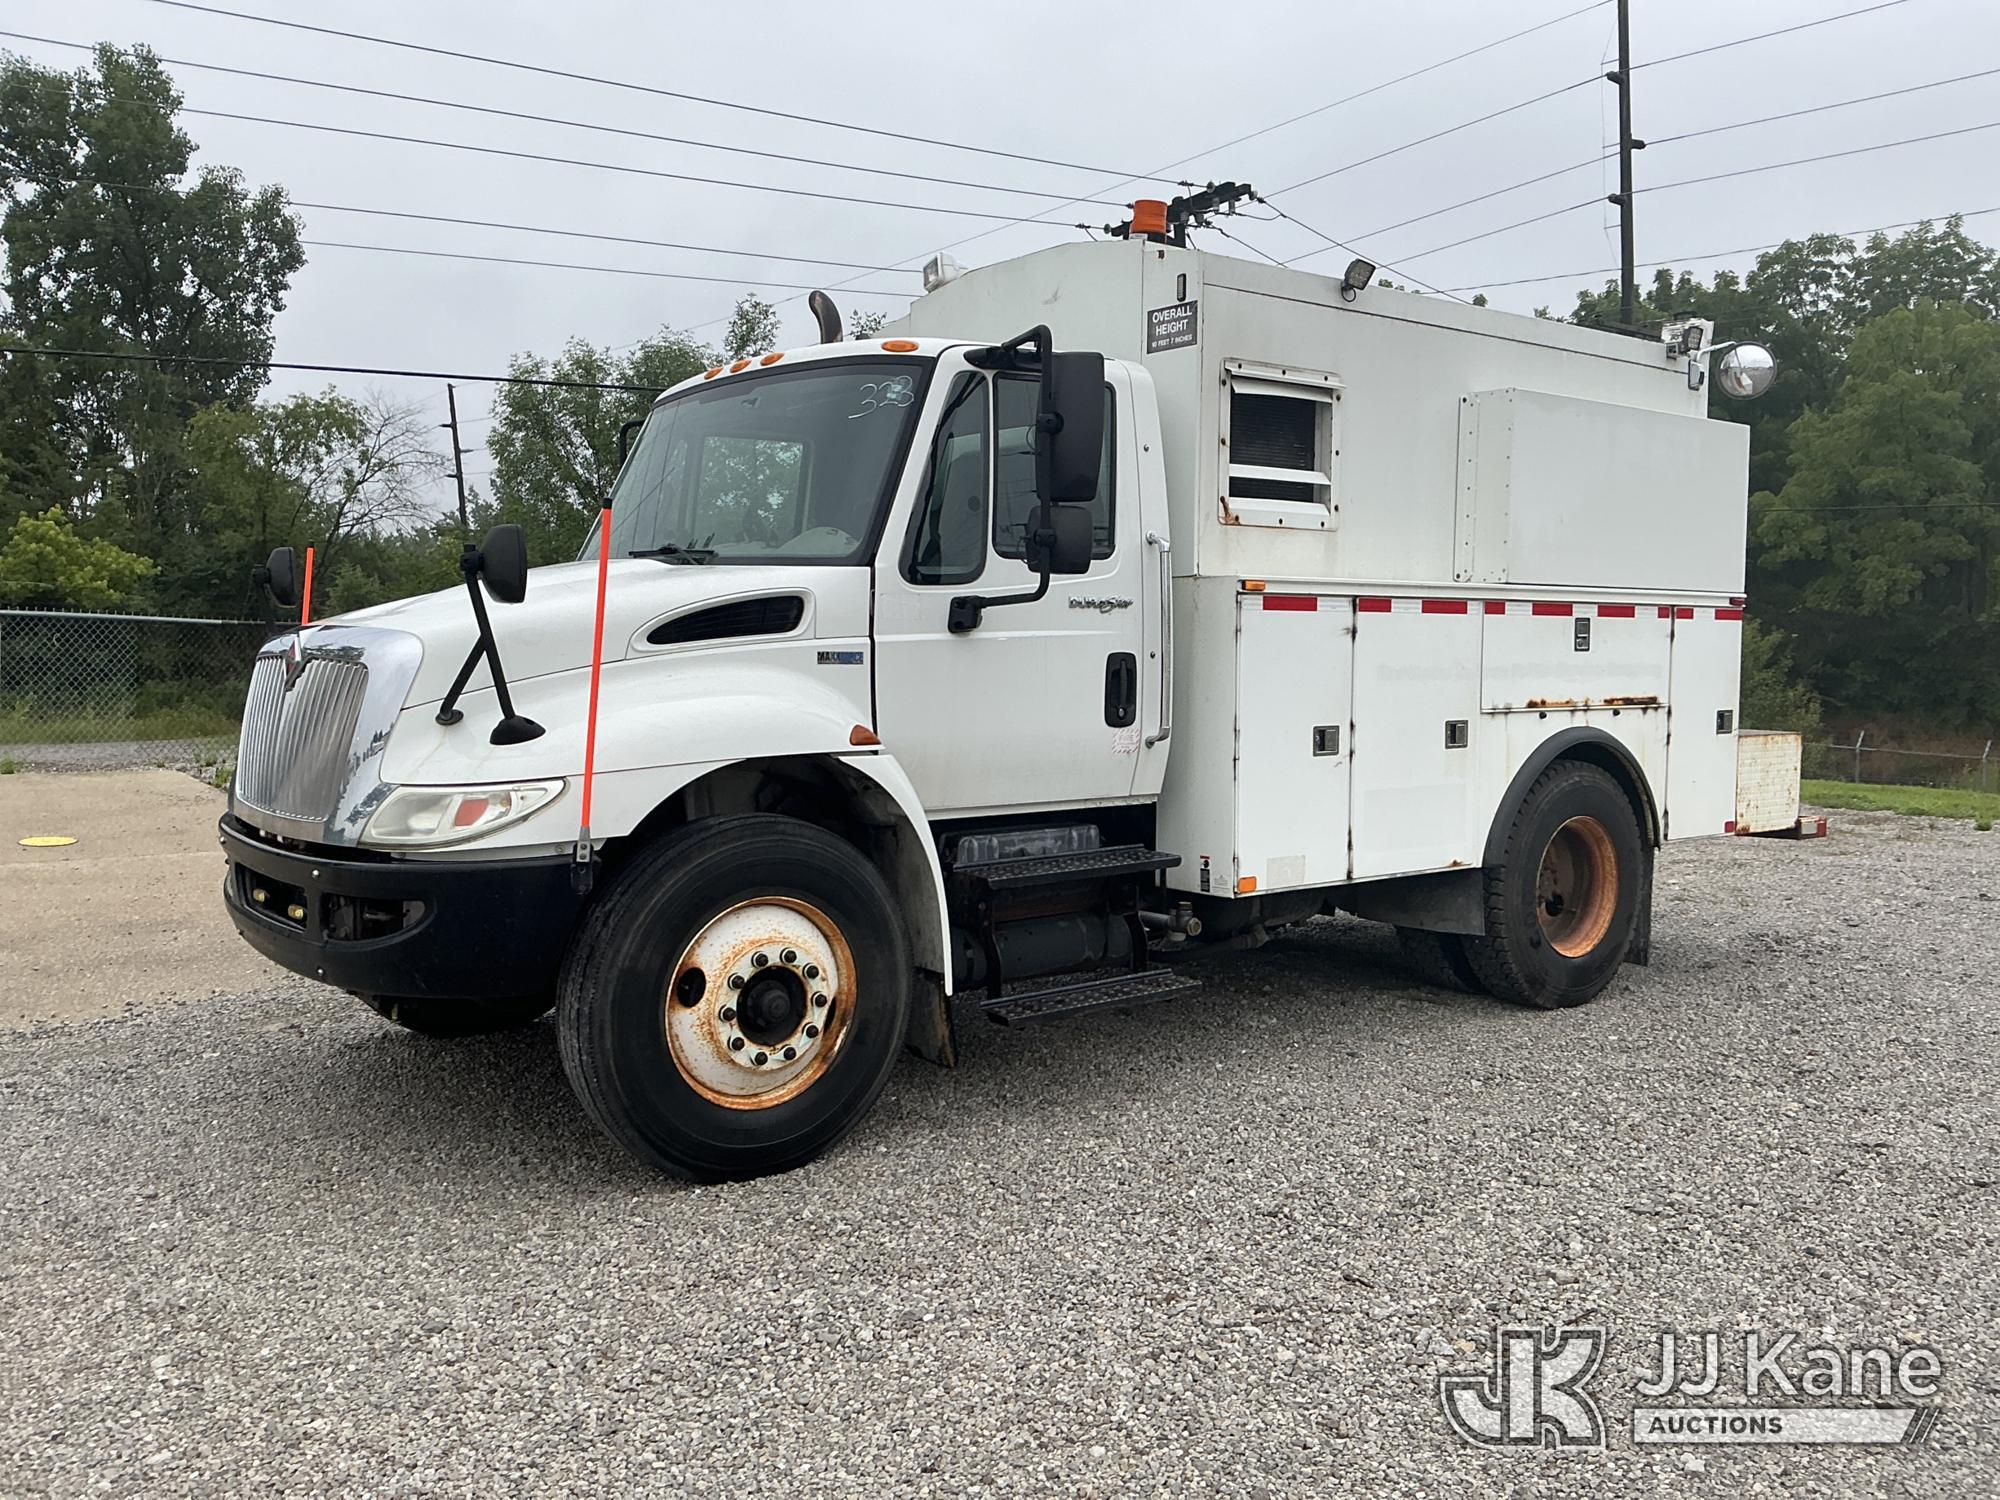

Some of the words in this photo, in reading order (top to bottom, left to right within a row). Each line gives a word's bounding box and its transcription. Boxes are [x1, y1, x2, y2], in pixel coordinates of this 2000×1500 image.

[1152, 305, 1193, 323] OVERALL
[1155, 319, 1188, 336] HEIGHT
[1158, 338, 1170, 346] FEET
[1175, 334, 1193, 343] INCHES
